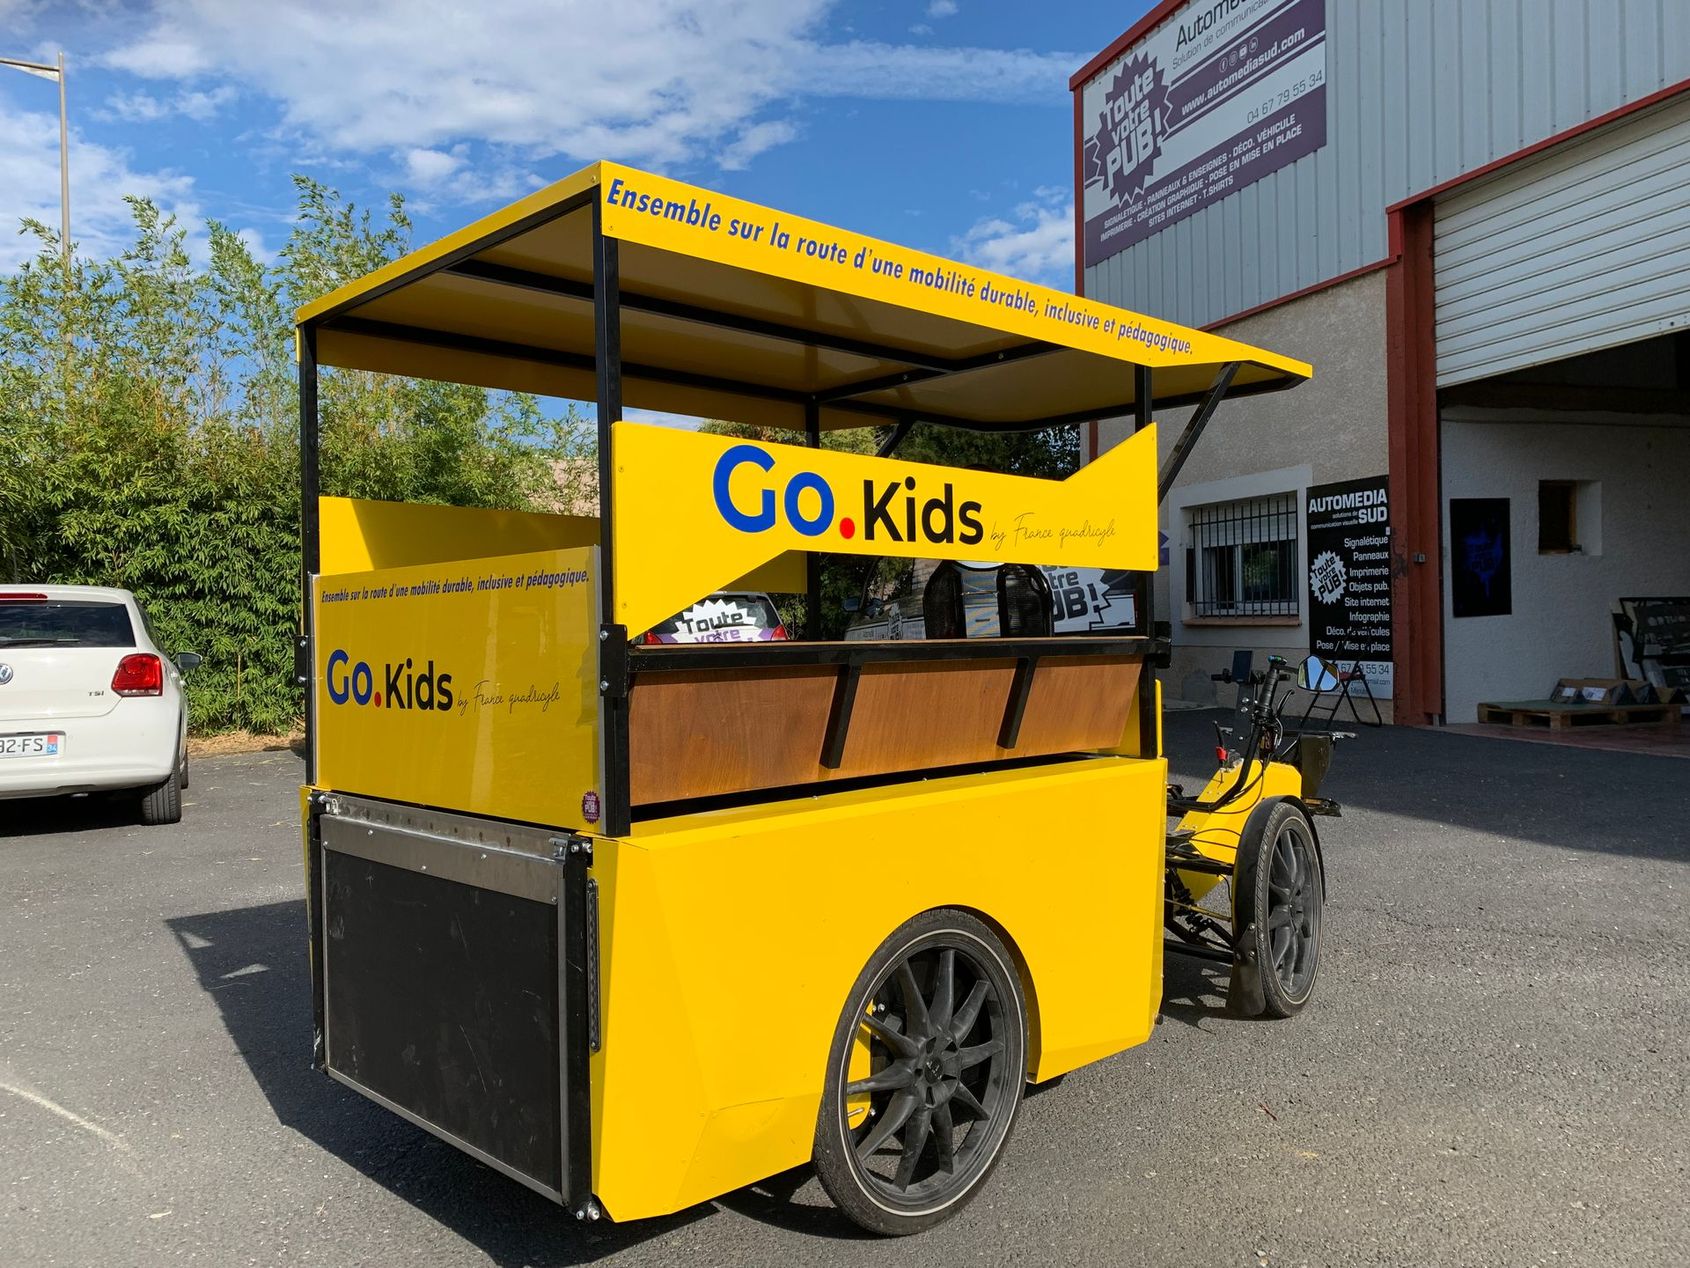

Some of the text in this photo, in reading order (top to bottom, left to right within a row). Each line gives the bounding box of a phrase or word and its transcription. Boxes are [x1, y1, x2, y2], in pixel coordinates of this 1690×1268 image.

[1176, 0, 1246, 52] Autome
[1172, 42, 1202, 69] Solution
[1203, 33, 1214, 47] de
[1181, 27, 1305, 116] www.automediasud.com
[1103, 67, 1154, 130] Toute
[1247, 70, 1323, 124] 04 67 79 55 34
[1111, 99, 1150, 146] votre
[1147, 181, 1181, 206] PANNEAUX
[1188, 152, 1228, 182] ENSEIGNES
[1232, 137, 1255, 158] DÉCO.
[1256, 113, 1296, 143] VÉHICULE
[1100, 123, 1302, 242] IMPRIMERIE CRÉATION GRAPHIQUE POSE EN MISE EN PLACE
[1148, 211, 1166, 228] SITES
[1166, 194, 1198, 218] INTERNET
[607, 178, 1194, 355] Ensemble sur la route d'une mobilité durable, inclusive et pédagogique.
[1308, 488, 1388, 514] AUTOMEDIA
[1358, 506, 1388, 524] SUD
[990, 520, 1006, 551] by
[1013, 511, 1053, 548] France
[1344, 535, 1389, 550] Signalétique
[1312, 556, 1336, 578] Toute
[1353, 551, 1389, 561] Panneaux
[1048, 571, 1079, 590] tre
[1318, 566, 1336, 584] votre
[1349, 565, 1389, 578] Imprimerie
[321, 568, 589, 603] Ensemble sur la route d'une mobilité durable, inclusive et pédagogique.
[1349, 581, 1389, 593] Objets pub.
[1344, 597, 1390, 607] Site internet
[681, 612, 744, 634] Toute
[1349, 611, 1389, 623] Infographie
[1326, 626, 1346, 636] Déco.
[1316, 640, 1334, 650] Pose
[1370, 641, 1390, 653] place
[1365, 664, 1377, 674] 55
[1378, 664, 1389, 675] 34
[457, 689, 469, 717] by
[473, 679, 504, 713] France
